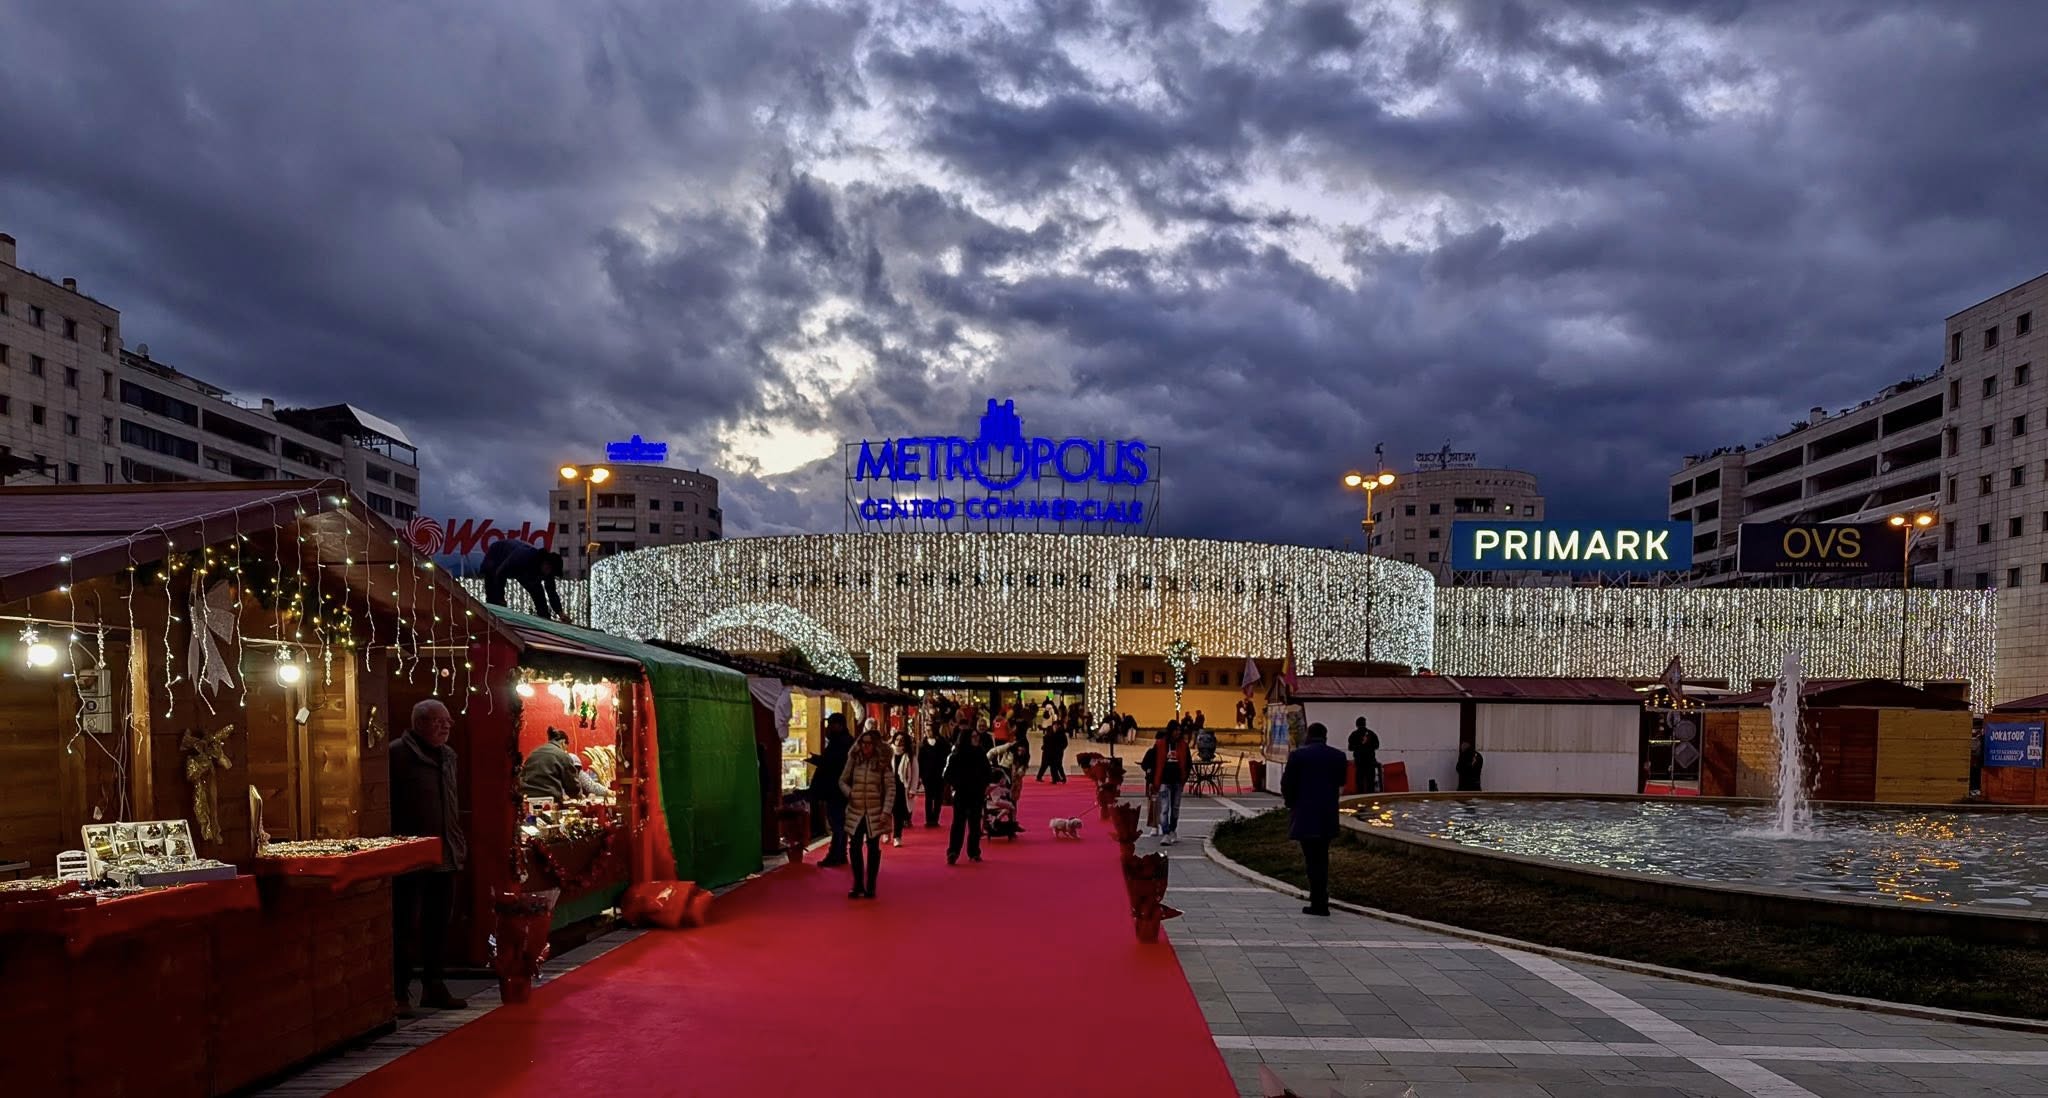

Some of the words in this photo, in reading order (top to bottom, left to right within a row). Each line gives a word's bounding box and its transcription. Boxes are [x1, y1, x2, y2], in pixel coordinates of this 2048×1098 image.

[856, 436, 1148, 491] METROPOLIS
[860, 497, 956, 521] CENTRO
[965, 497, 1143, 523] COMMERCIALE
[1474, 529, 1669, 560] PRIMARK
[1783, 527, 1861, 559] OVS
